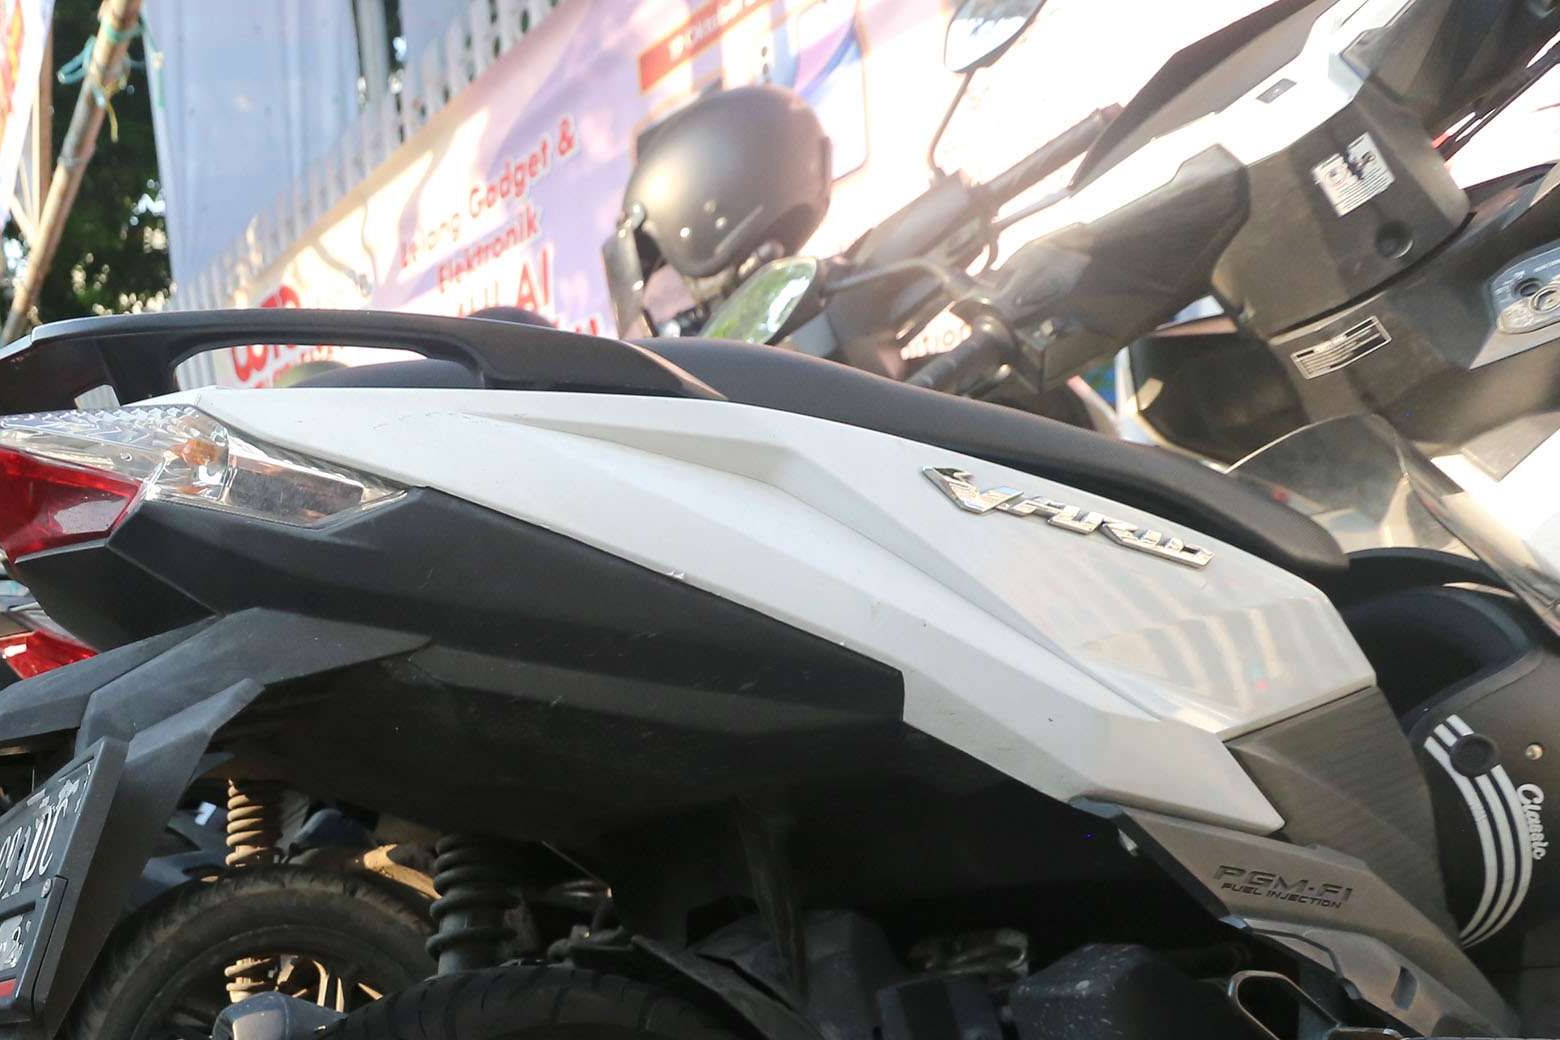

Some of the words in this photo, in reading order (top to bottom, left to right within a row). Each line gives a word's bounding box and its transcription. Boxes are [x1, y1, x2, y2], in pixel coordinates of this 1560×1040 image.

[468, 138, 549, 219] Gadget
[557, 117, 576, 157] &
[1213, 864, 1354, 902] PGM-FI
[1220, 882, 1263, 896] FUEL
[1266, 890, 1343, 909] INJECTION
